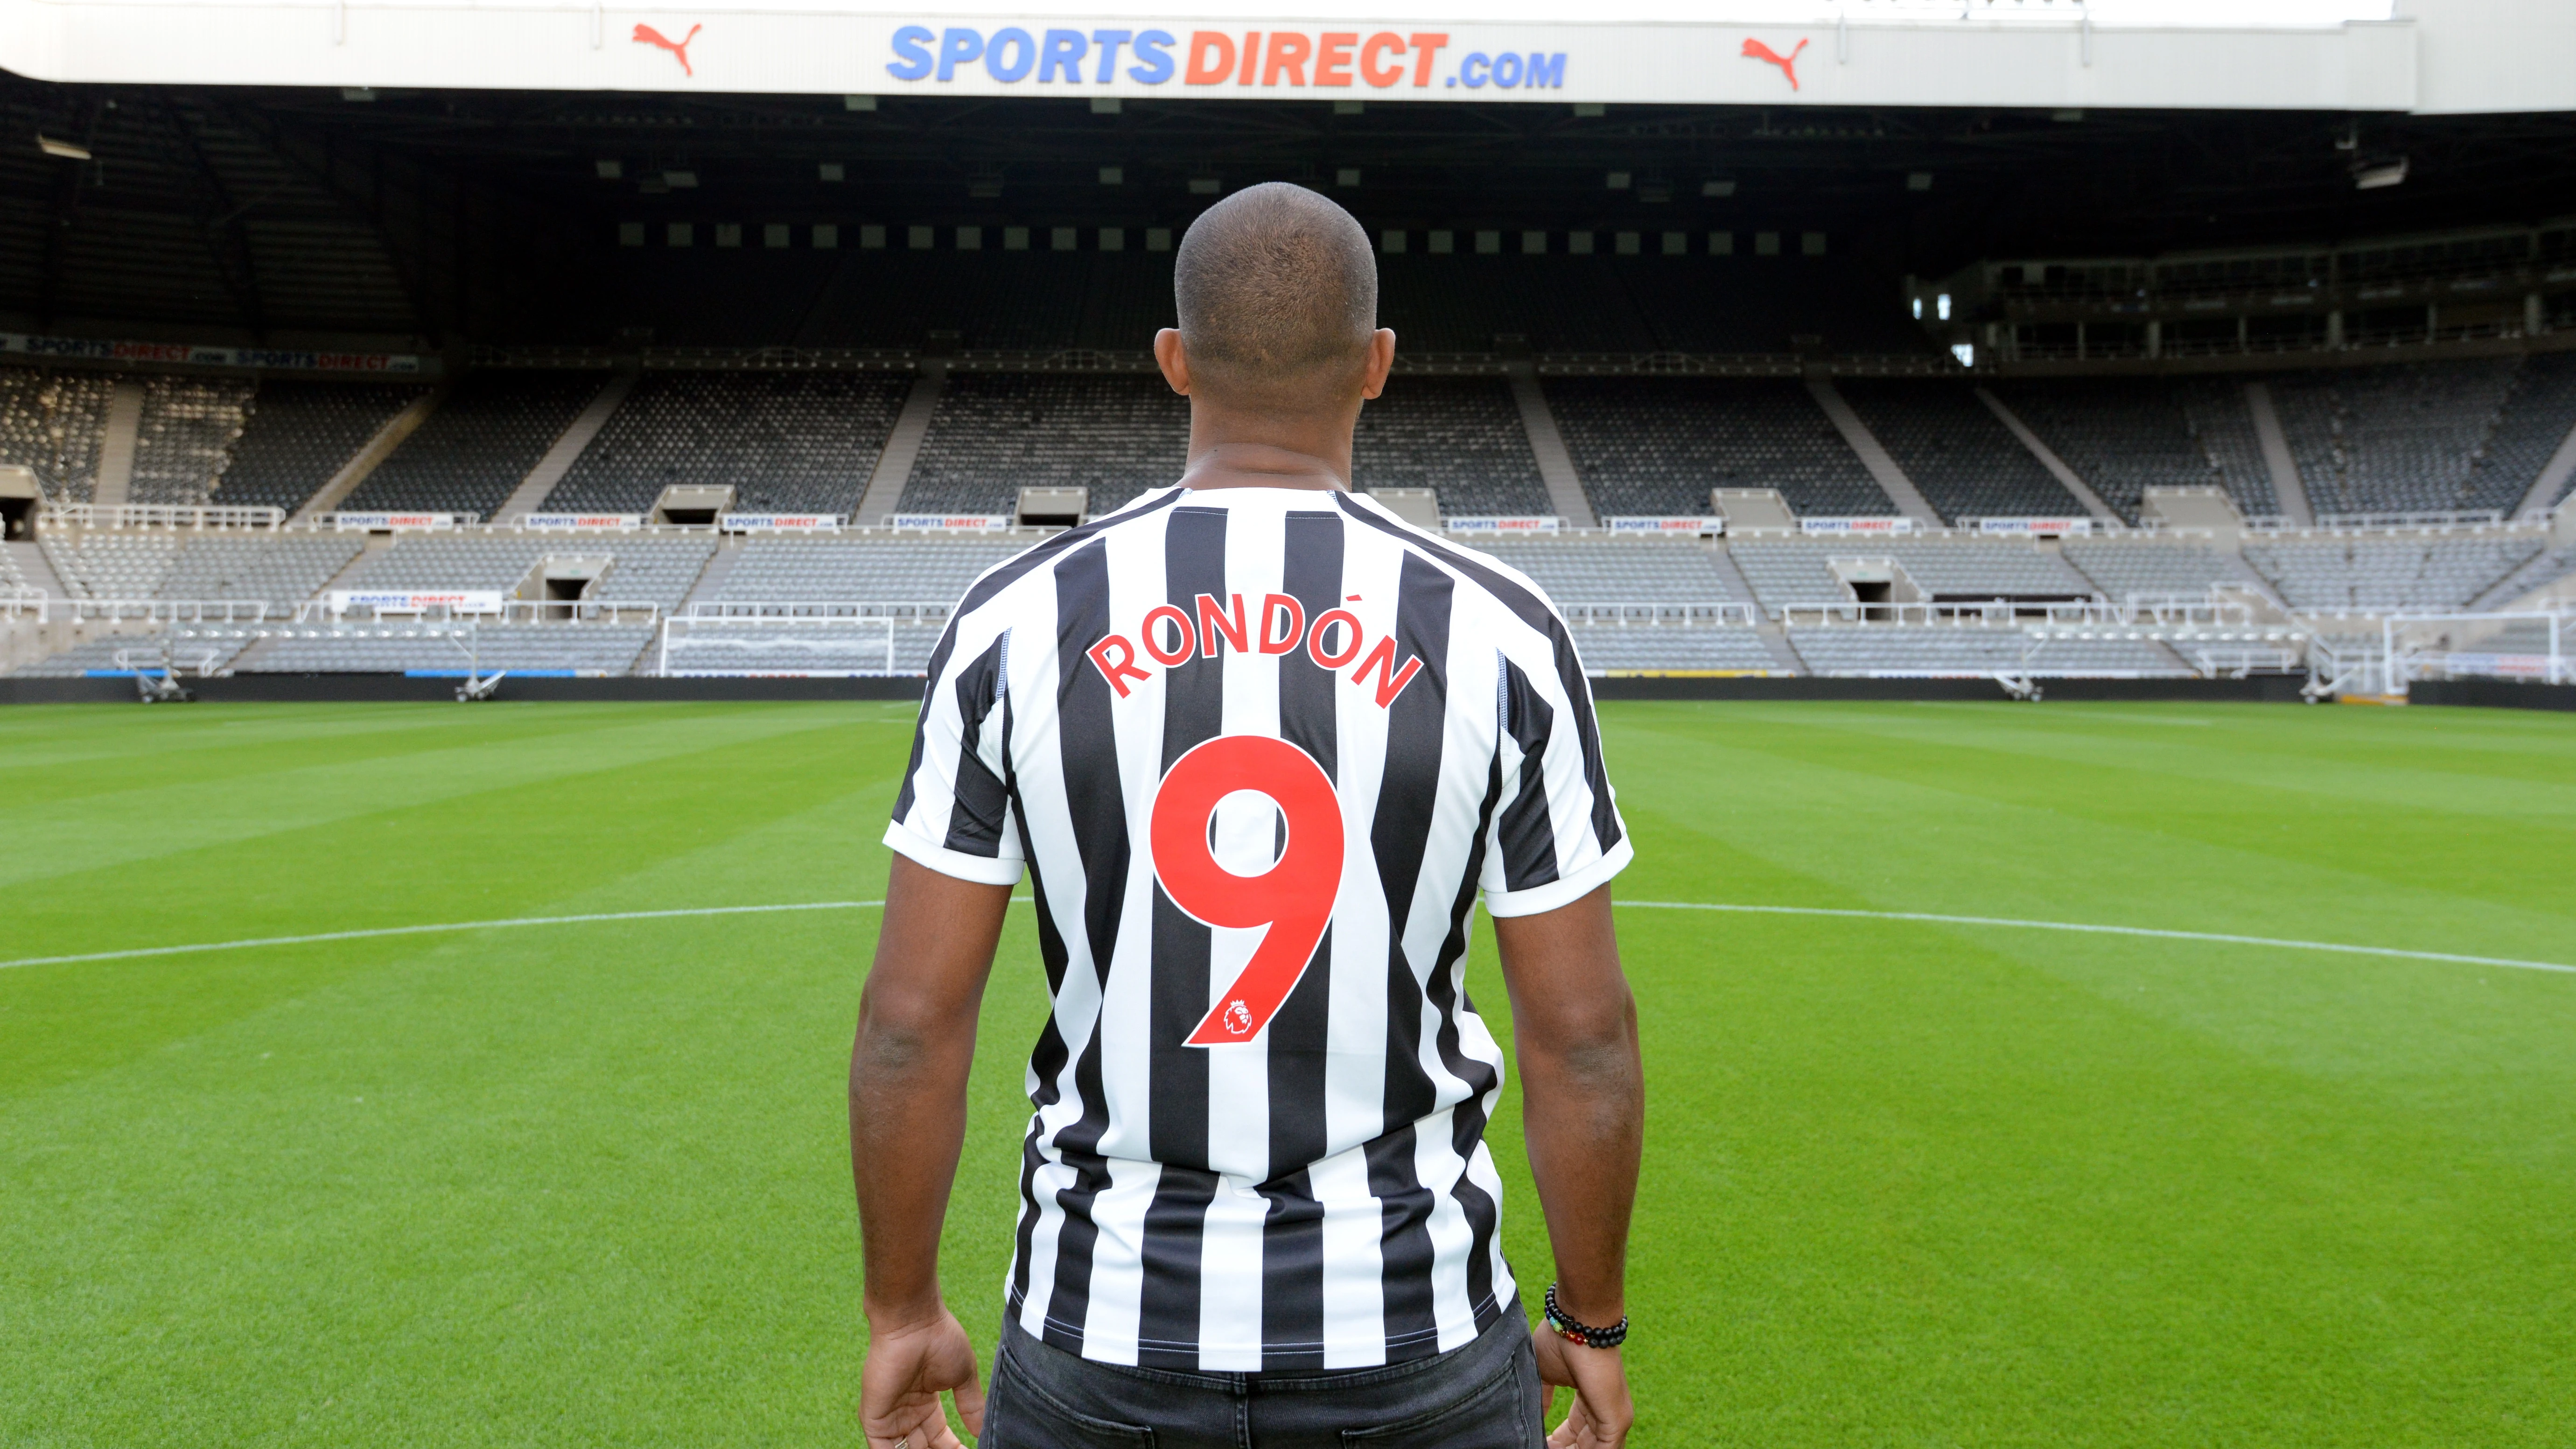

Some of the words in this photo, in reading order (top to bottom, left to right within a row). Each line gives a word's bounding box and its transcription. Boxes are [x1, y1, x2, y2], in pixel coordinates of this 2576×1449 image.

[886, 25, 1567, 88] SPORTSDIRECT.COM
[1086, 594, 1423, 709] RONDÓN
[1149, 735, 1346, 1046] 9
